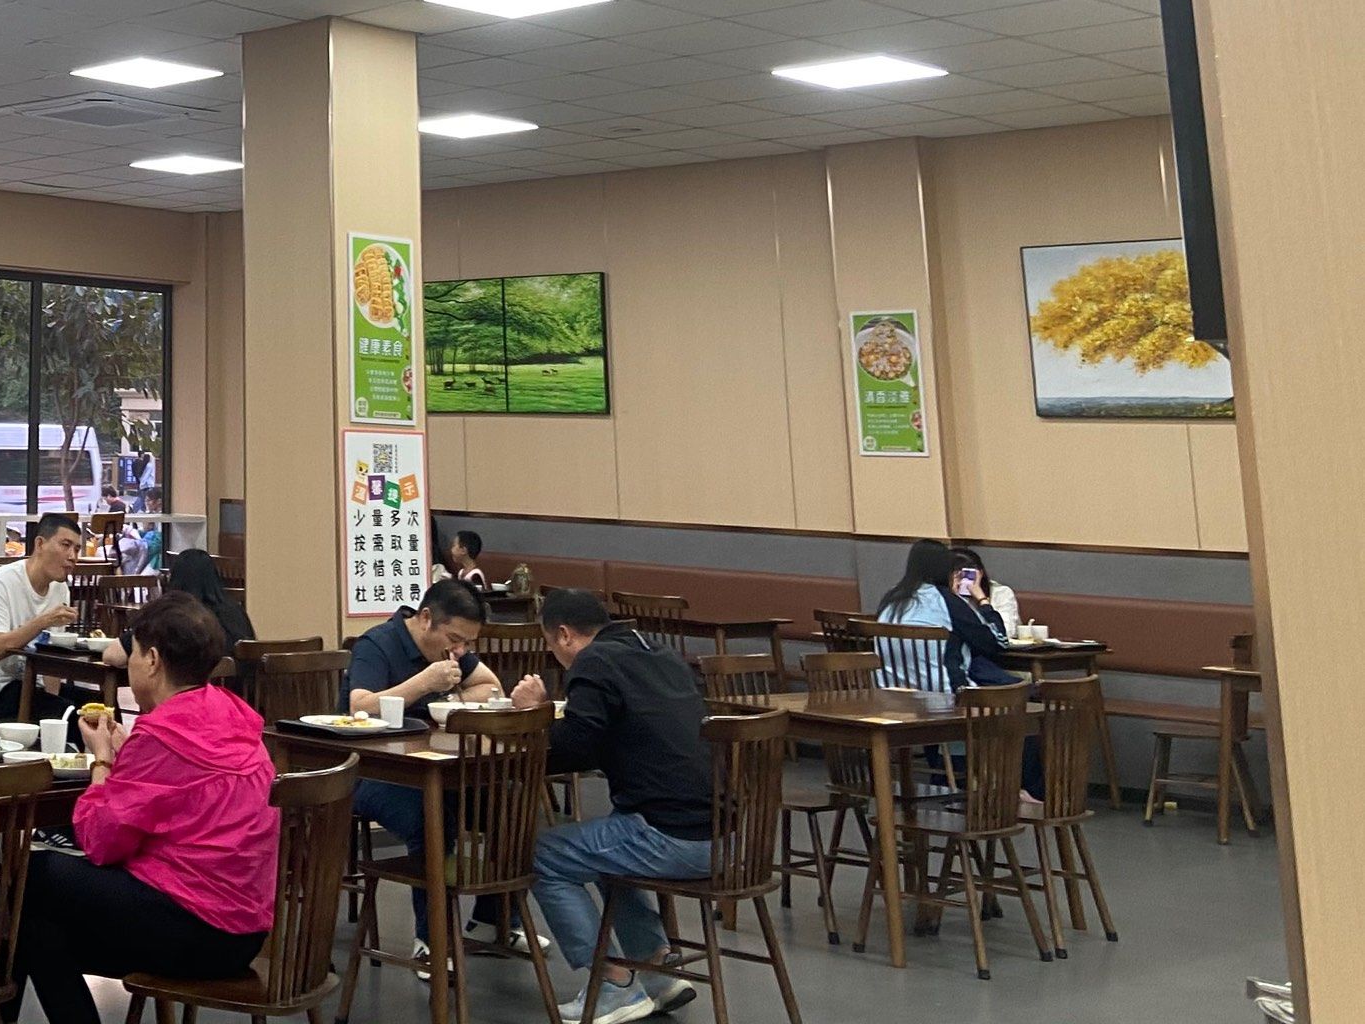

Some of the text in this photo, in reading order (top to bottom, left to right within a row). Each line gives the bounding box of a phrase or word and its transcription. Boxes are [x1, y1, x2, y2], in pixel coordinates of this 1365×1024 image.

[359, 337, 403, 356] 健康素食
[353, 508, 420, 527] 少量多次
[354, 534, 420, 552] 按需取量
[354, 558, 421, 578] 珍惜食品
[354, 583, 421, 603] 杜绝浪费
